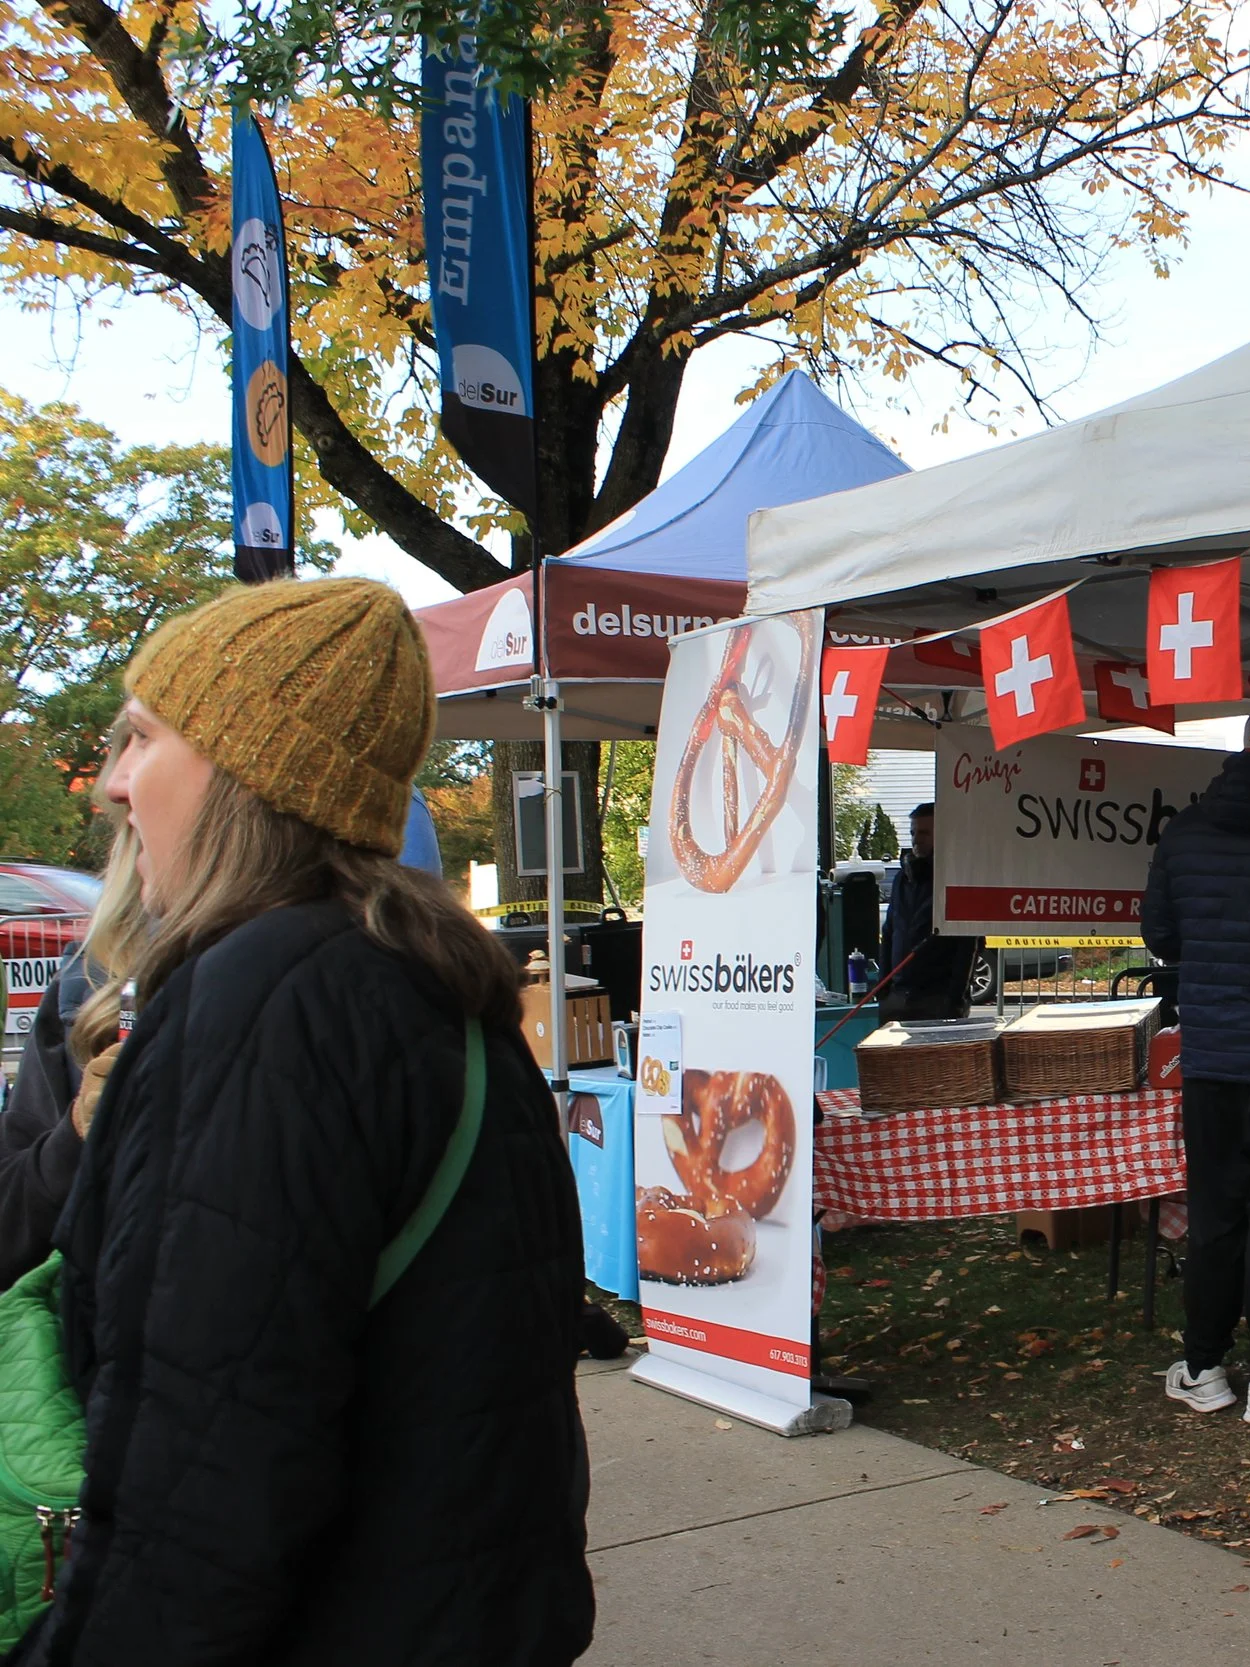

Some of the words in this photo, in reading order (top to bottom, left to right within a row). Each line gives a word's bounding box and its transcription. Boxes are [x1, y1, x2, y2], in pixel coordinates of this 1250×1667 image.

[458, 379, 518, 406] delSur
[490, 631, 528, 659] delSur
[1009, 894, 1107, 916] CATERING
[1006, 938, 1060, 946] CAUTION
[1078, 938, 1134, 946] CAUTION
[3, 960, 57, 988] ROOM
[712, 1002, 724, 1010] our
[725, 1000, 739, 1011] food
[740, 1001, 757, 1011] makes
[778, 1002, 794, 1013] good
